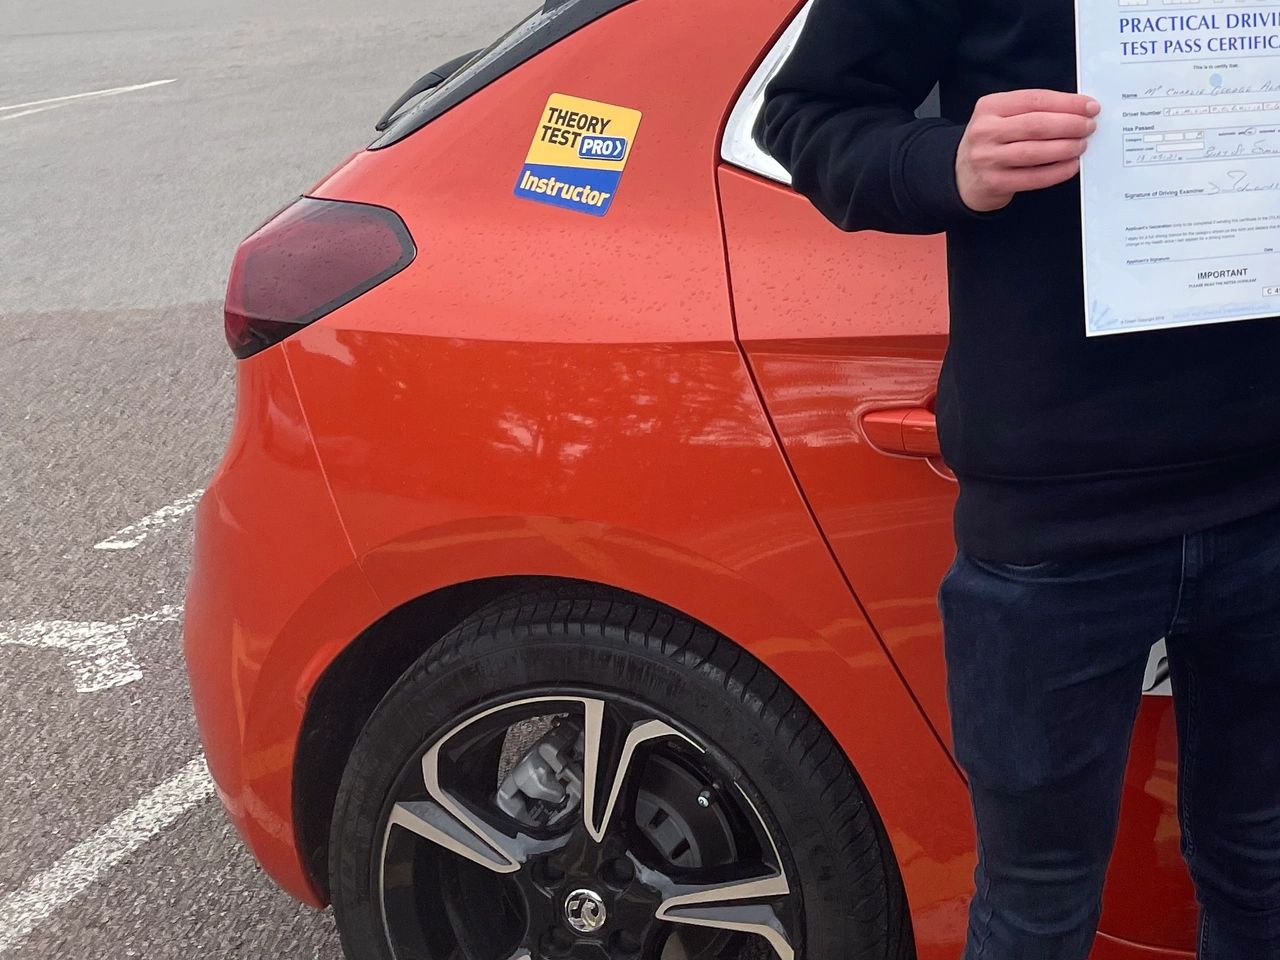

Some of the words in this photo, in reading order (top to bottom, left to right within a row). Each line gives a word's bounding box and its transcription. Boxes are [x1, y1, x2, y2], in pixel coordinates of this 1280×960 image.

[1119, 13, 1220, 34] PRACTICAL
[1120, 40, 1158, 56] TEST
[1164, 38, 1202, 54] PASS
[548, 106, 612, 135] THEORY
[540, 125, 582, 149] TEST
[581, 139, 613, 156] PRO
[519, 169, 611, 208] Instructor
[1158, 189, 1178, 197] Driving
[1197, 268, 1249, 280] IMPORTANT
